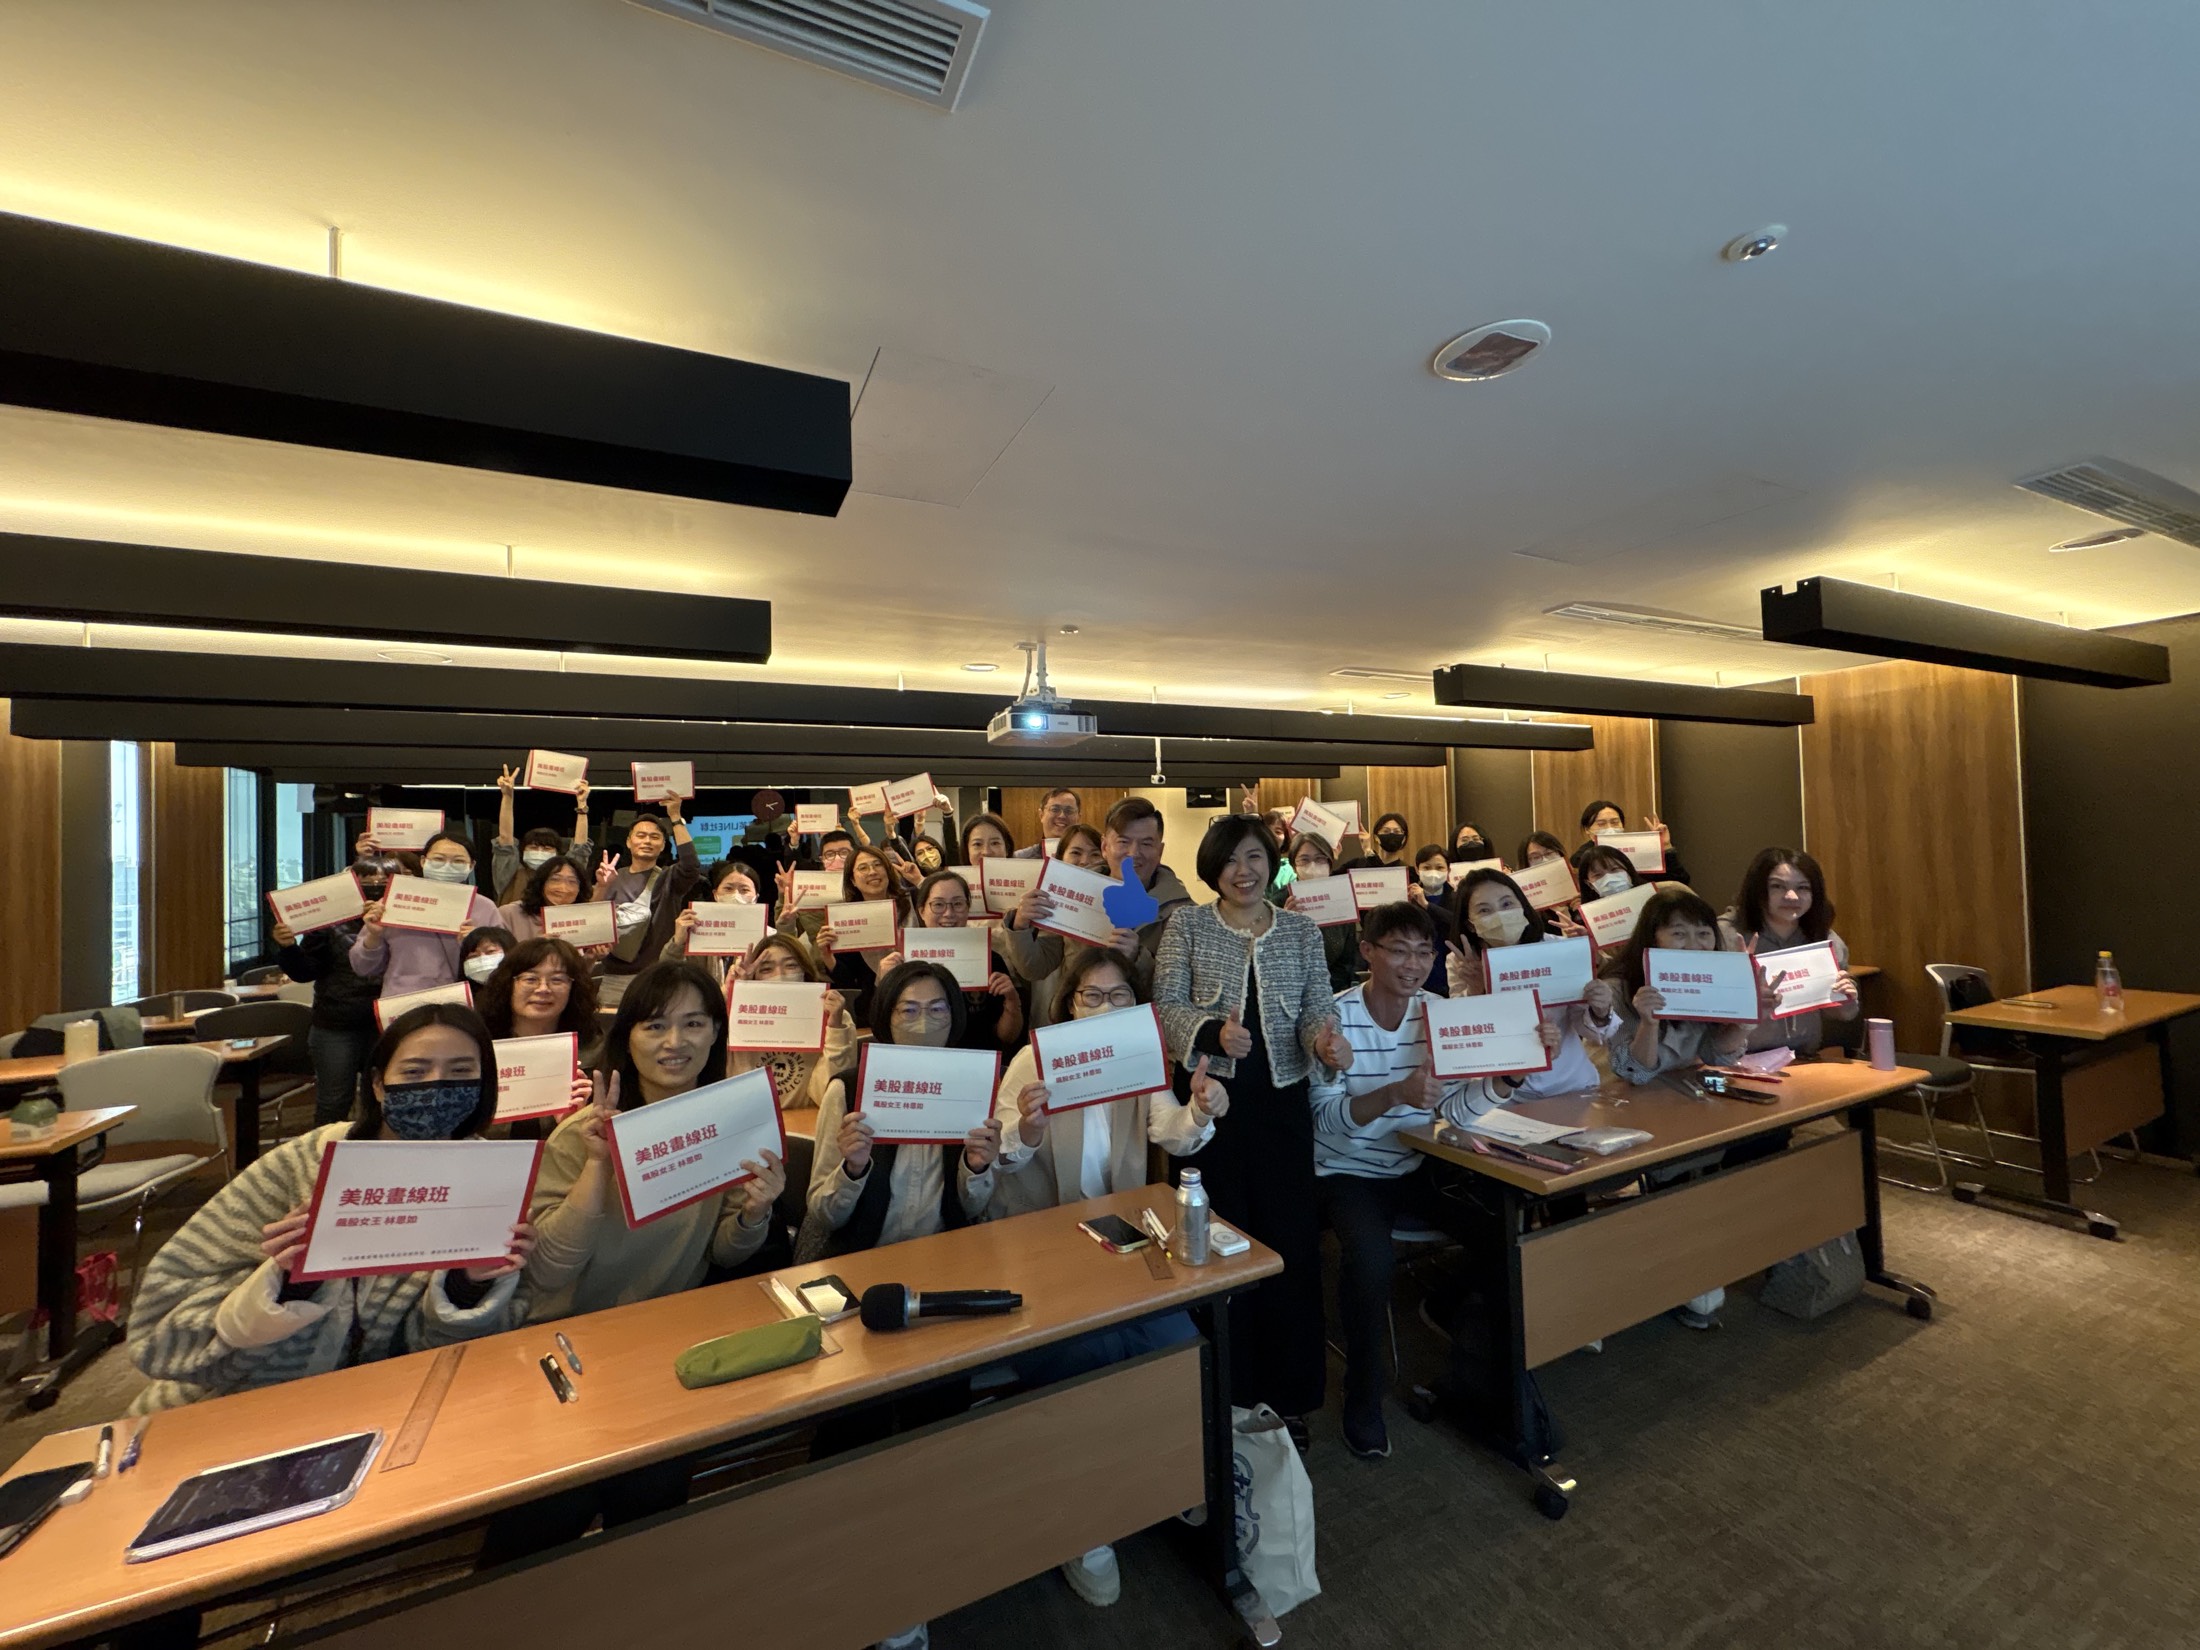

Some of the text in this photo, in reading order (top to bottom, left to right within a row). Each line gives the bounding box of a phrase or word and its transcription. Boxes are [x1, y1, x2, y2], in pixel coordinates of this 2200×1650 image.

[989, 879, 1026, 888] 美股畫線班
[1048, 883, 1095, 906] 美股畫線班
[911, 948, 955, 958] 美股畫線班
[1498, 966, 1552, 981] 美股畫線班
[1658, 972, 1713, 983] 美股畫線班
[738, 1004, 788, 1015] 美股畫線班
[1438, 1023, 1495, 1038] 美股畫線班
[1051, 1045, 1115, 1070] 美股畫線班
[873, 1079, 943, 1095] 美股畫線班
[634, 1123, 719, 1165] 美股畫線班
[338, 1186, 450, 1206] 美股畫線班
